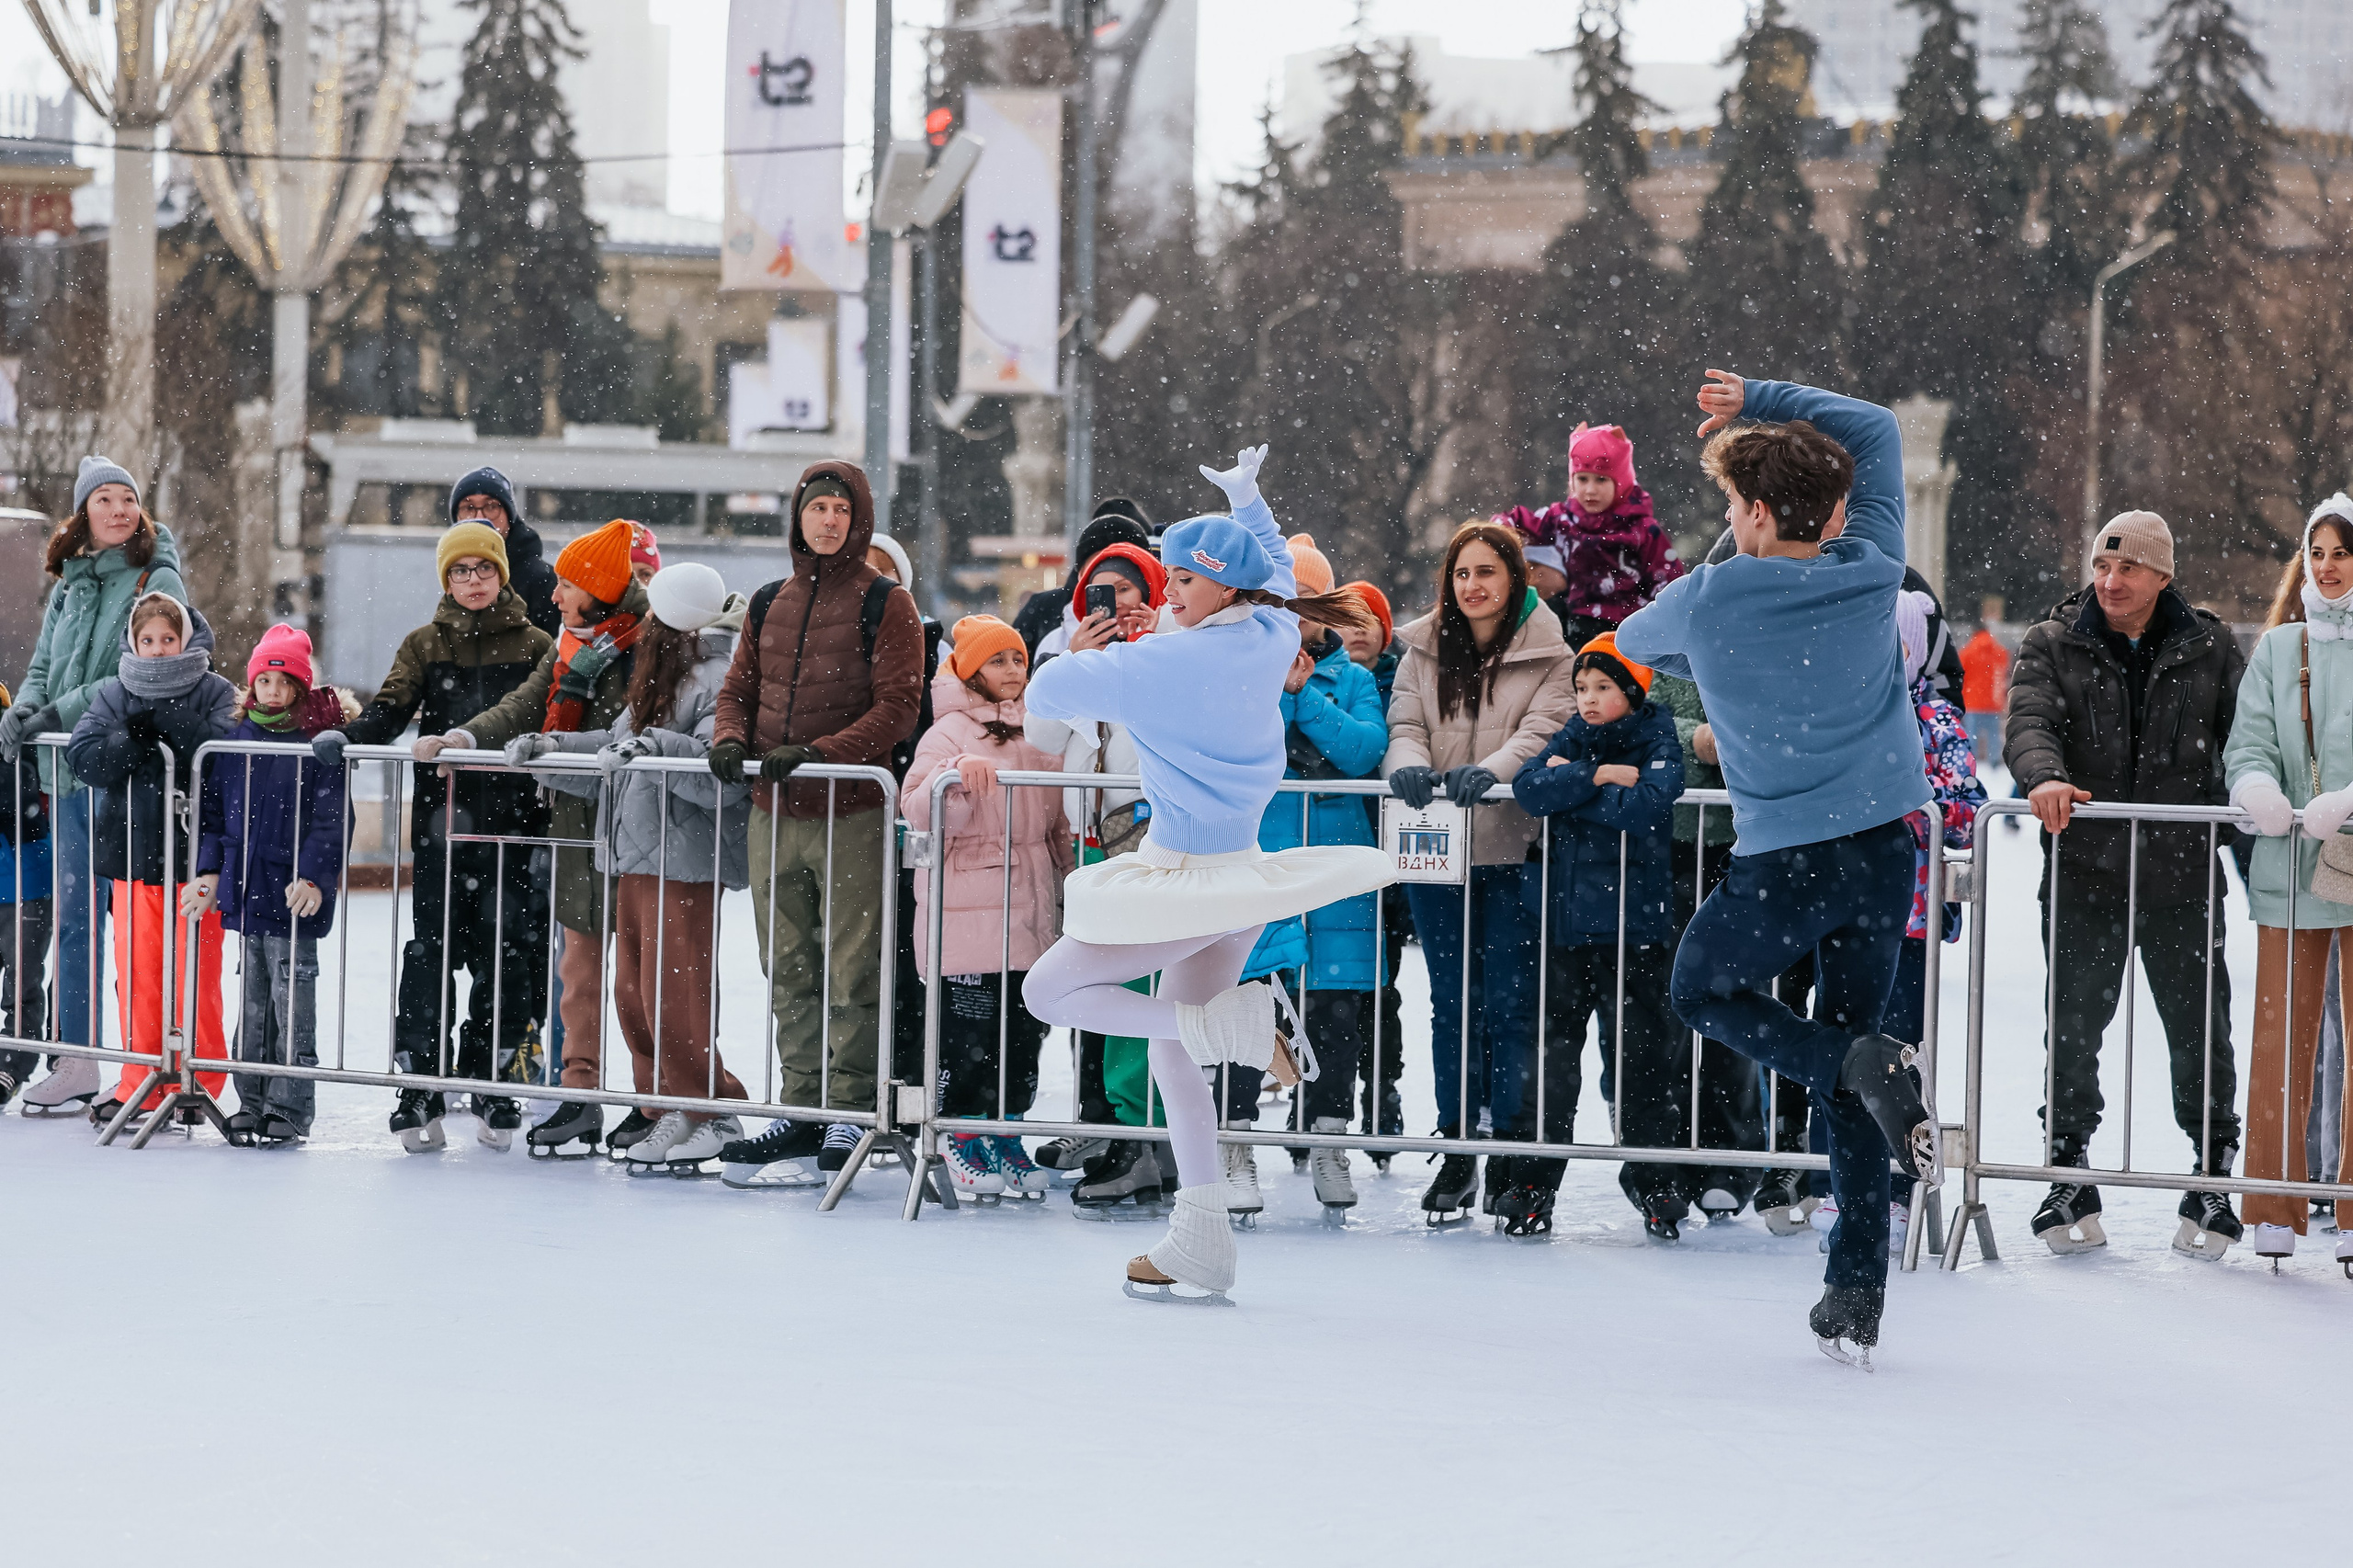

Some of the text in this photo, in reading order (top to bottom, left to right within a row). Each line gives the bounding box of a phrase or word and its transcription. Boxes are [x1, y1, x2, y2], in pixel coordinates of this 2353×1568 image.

[749, 50, 814, 107] t2
[987, 223, 1036, 263] t2
[1398, 856, 1449, 871] ВДНХ
